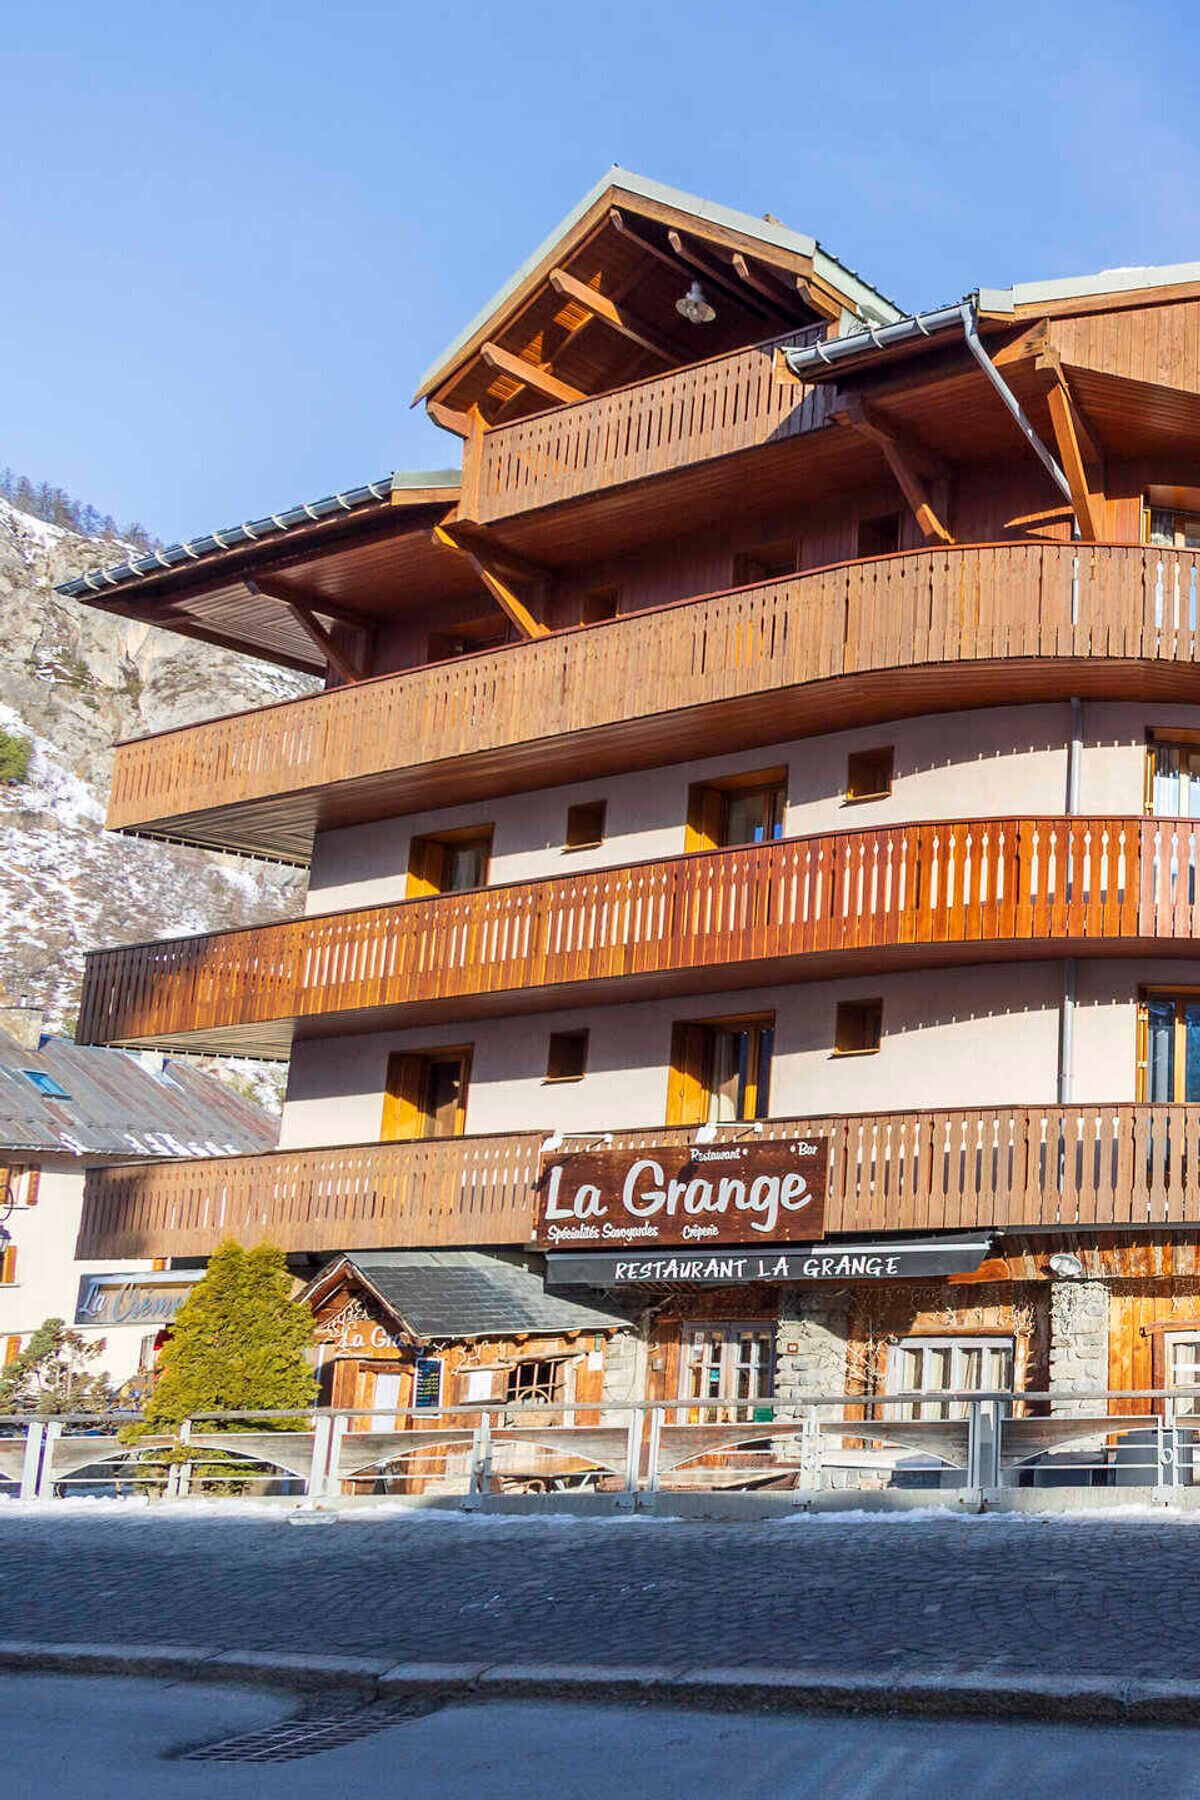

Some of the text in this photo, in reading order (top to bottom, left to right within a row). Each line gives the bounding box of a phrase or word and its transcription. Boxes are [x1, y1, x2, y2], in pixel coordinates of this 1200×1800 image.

[690, 1147, 741, 1161] Restaurant
[797, 1141, 818, 1156] Bar
[544, 1159, 812, 1233] La Grange
[601, 1220, 659, 1243] Savoyardes
[615, 1256, 901, 1280] RESTAURANT LA GRANGE
[338, 1324, 366, 1349] La
